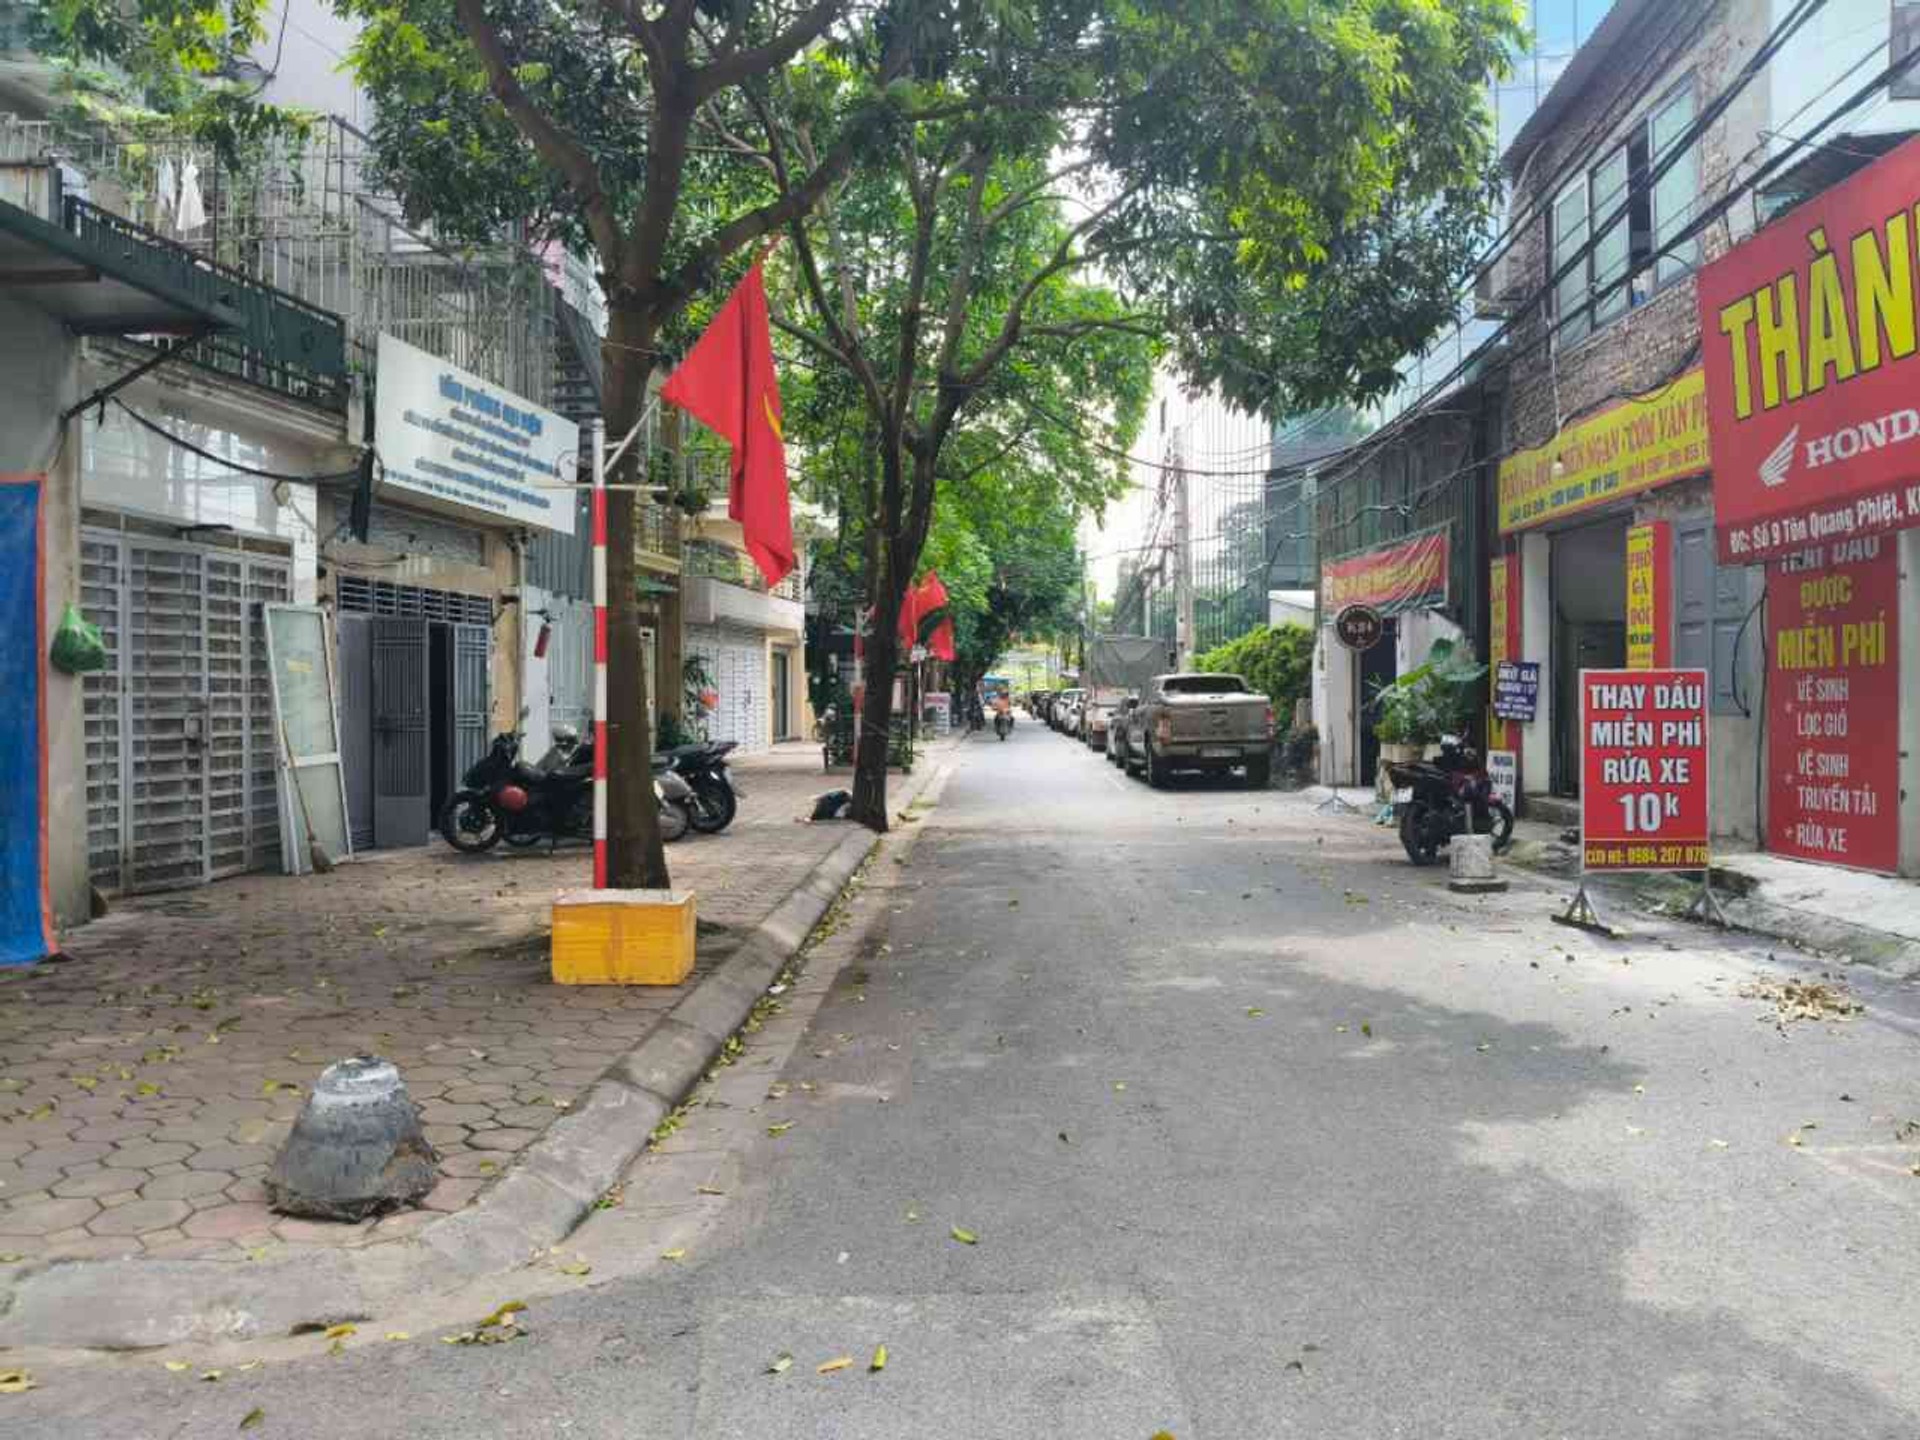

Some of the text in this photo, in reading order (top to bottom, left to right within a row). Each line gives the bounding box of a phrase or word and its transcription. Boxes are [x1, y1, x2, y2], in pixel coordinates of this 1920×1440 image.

[1719, 201, 1920, 421] THÀN
[1805, 408, 1920, 469] HOND
[1771, 522, 1781, 546] 9
[1809, 506, 1853, 540] Quang
[1777, 609, 1885, 669] MIỄN PHÍ
[1589, 684, 1646, 710] THAY
[1816, 678, 1849, 701] SINH
[1591, 713, 1702, 747] MIỄN PHÍ
[1798, 707, 1848, 739] LỌC GIÓ
[1604, 750, 1690, 784] RỬA XE
[1816, 753, 1849, 777] SINH
[1826, 828, 1848, 853] XE
